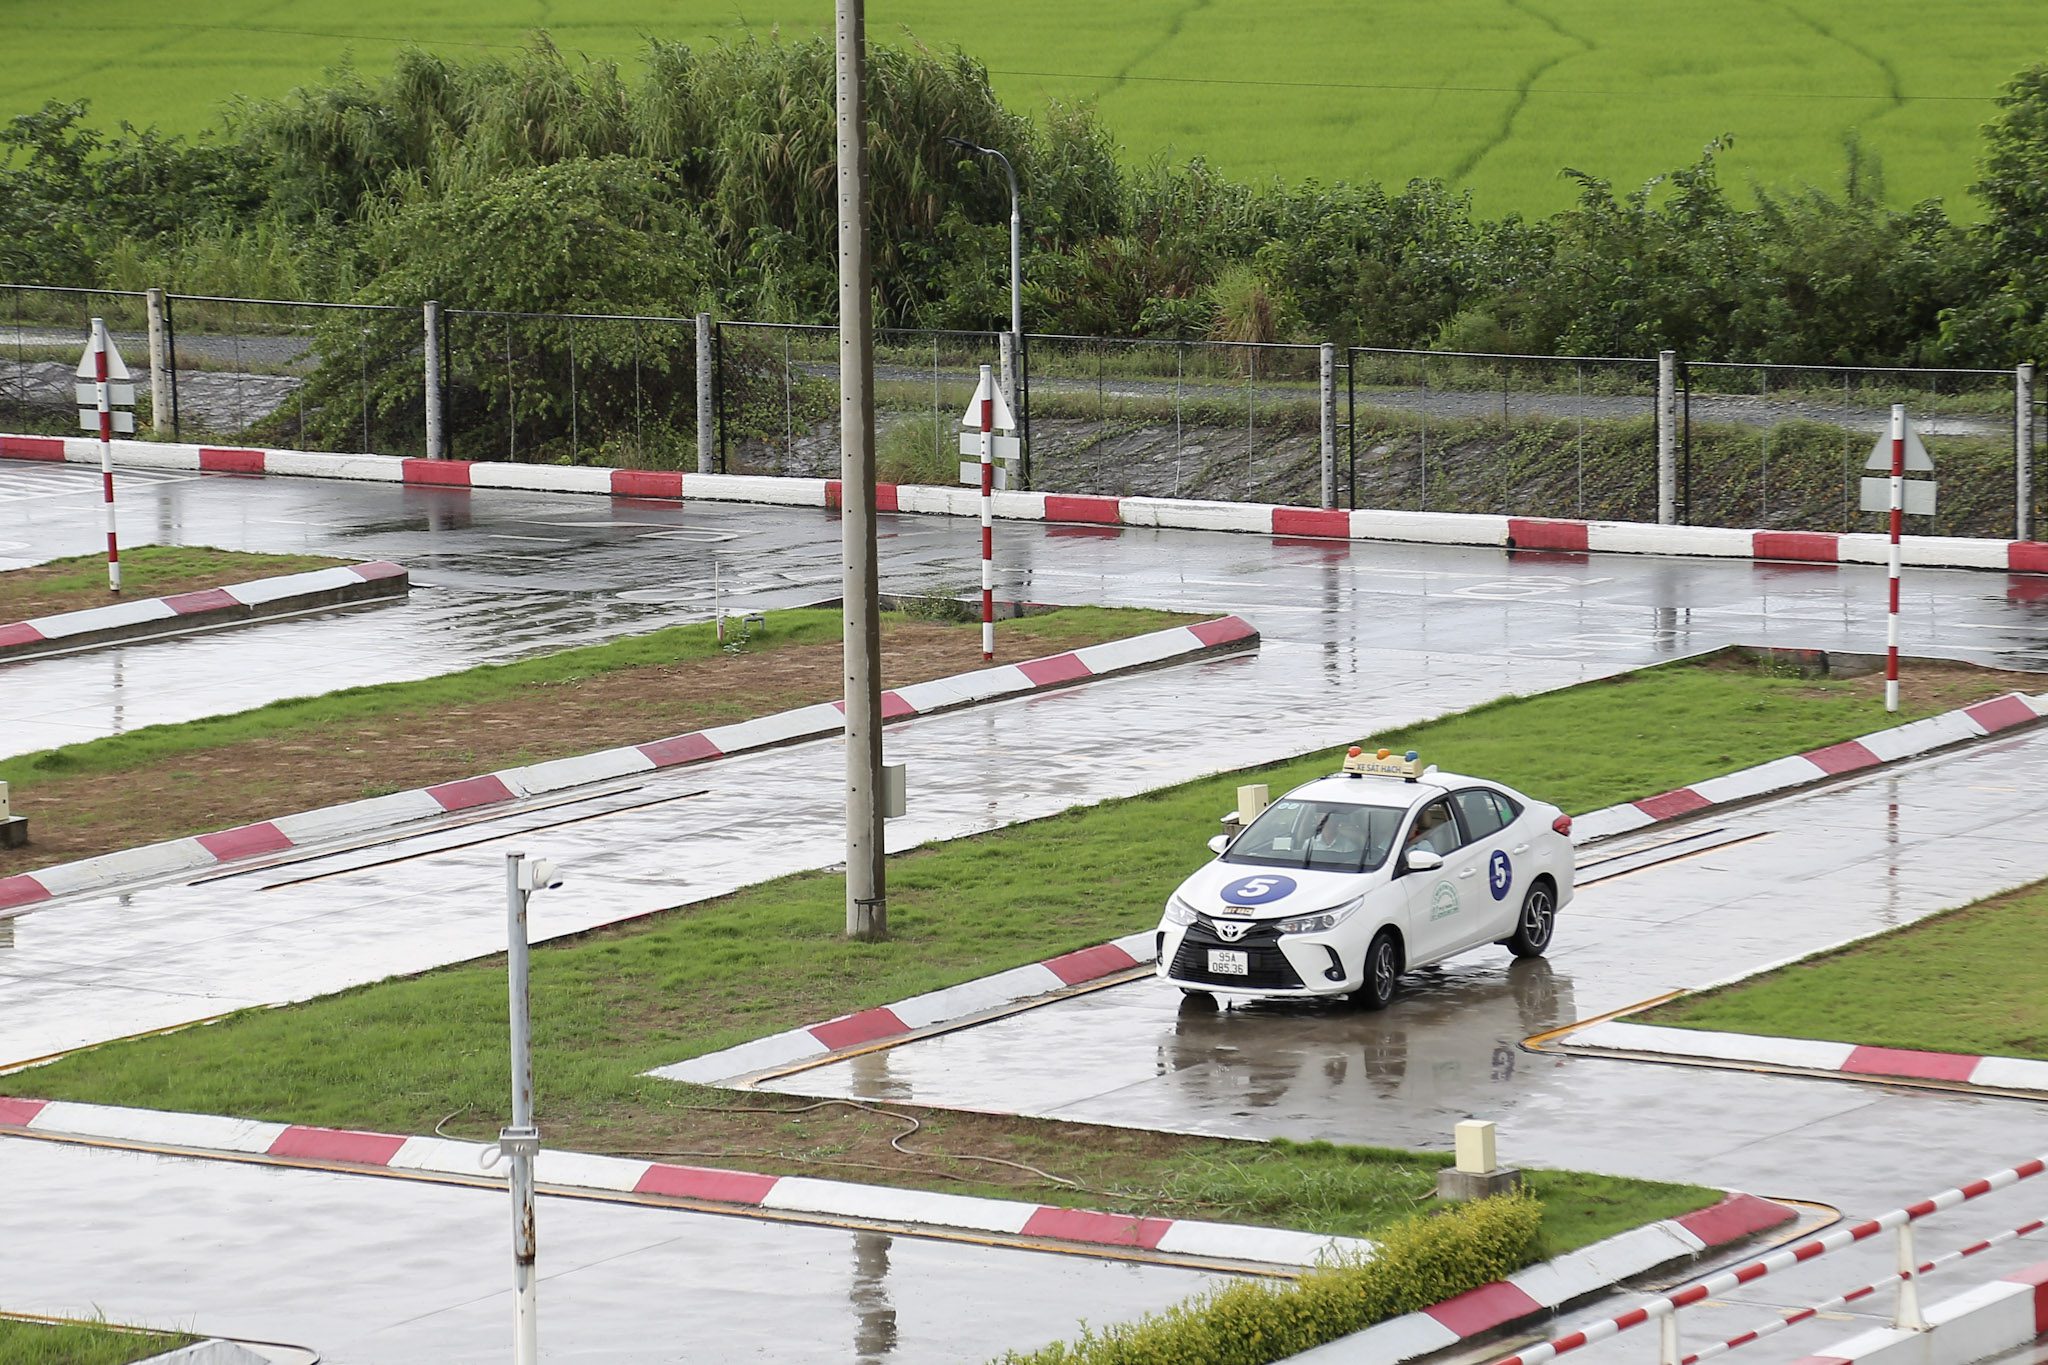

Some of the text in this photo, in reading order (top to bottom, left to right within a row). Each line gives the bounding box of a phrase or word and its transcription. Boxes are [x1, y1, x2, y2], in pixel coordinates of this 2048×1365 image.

[1357, 764, 1365, 772] XE
[1494, 856, 1506, 889] 5
[1237, 878, 1279, 897] 5
[1219, 952, 1236, 962] 95A
[1212, 962, 1244, 974] 085.36
